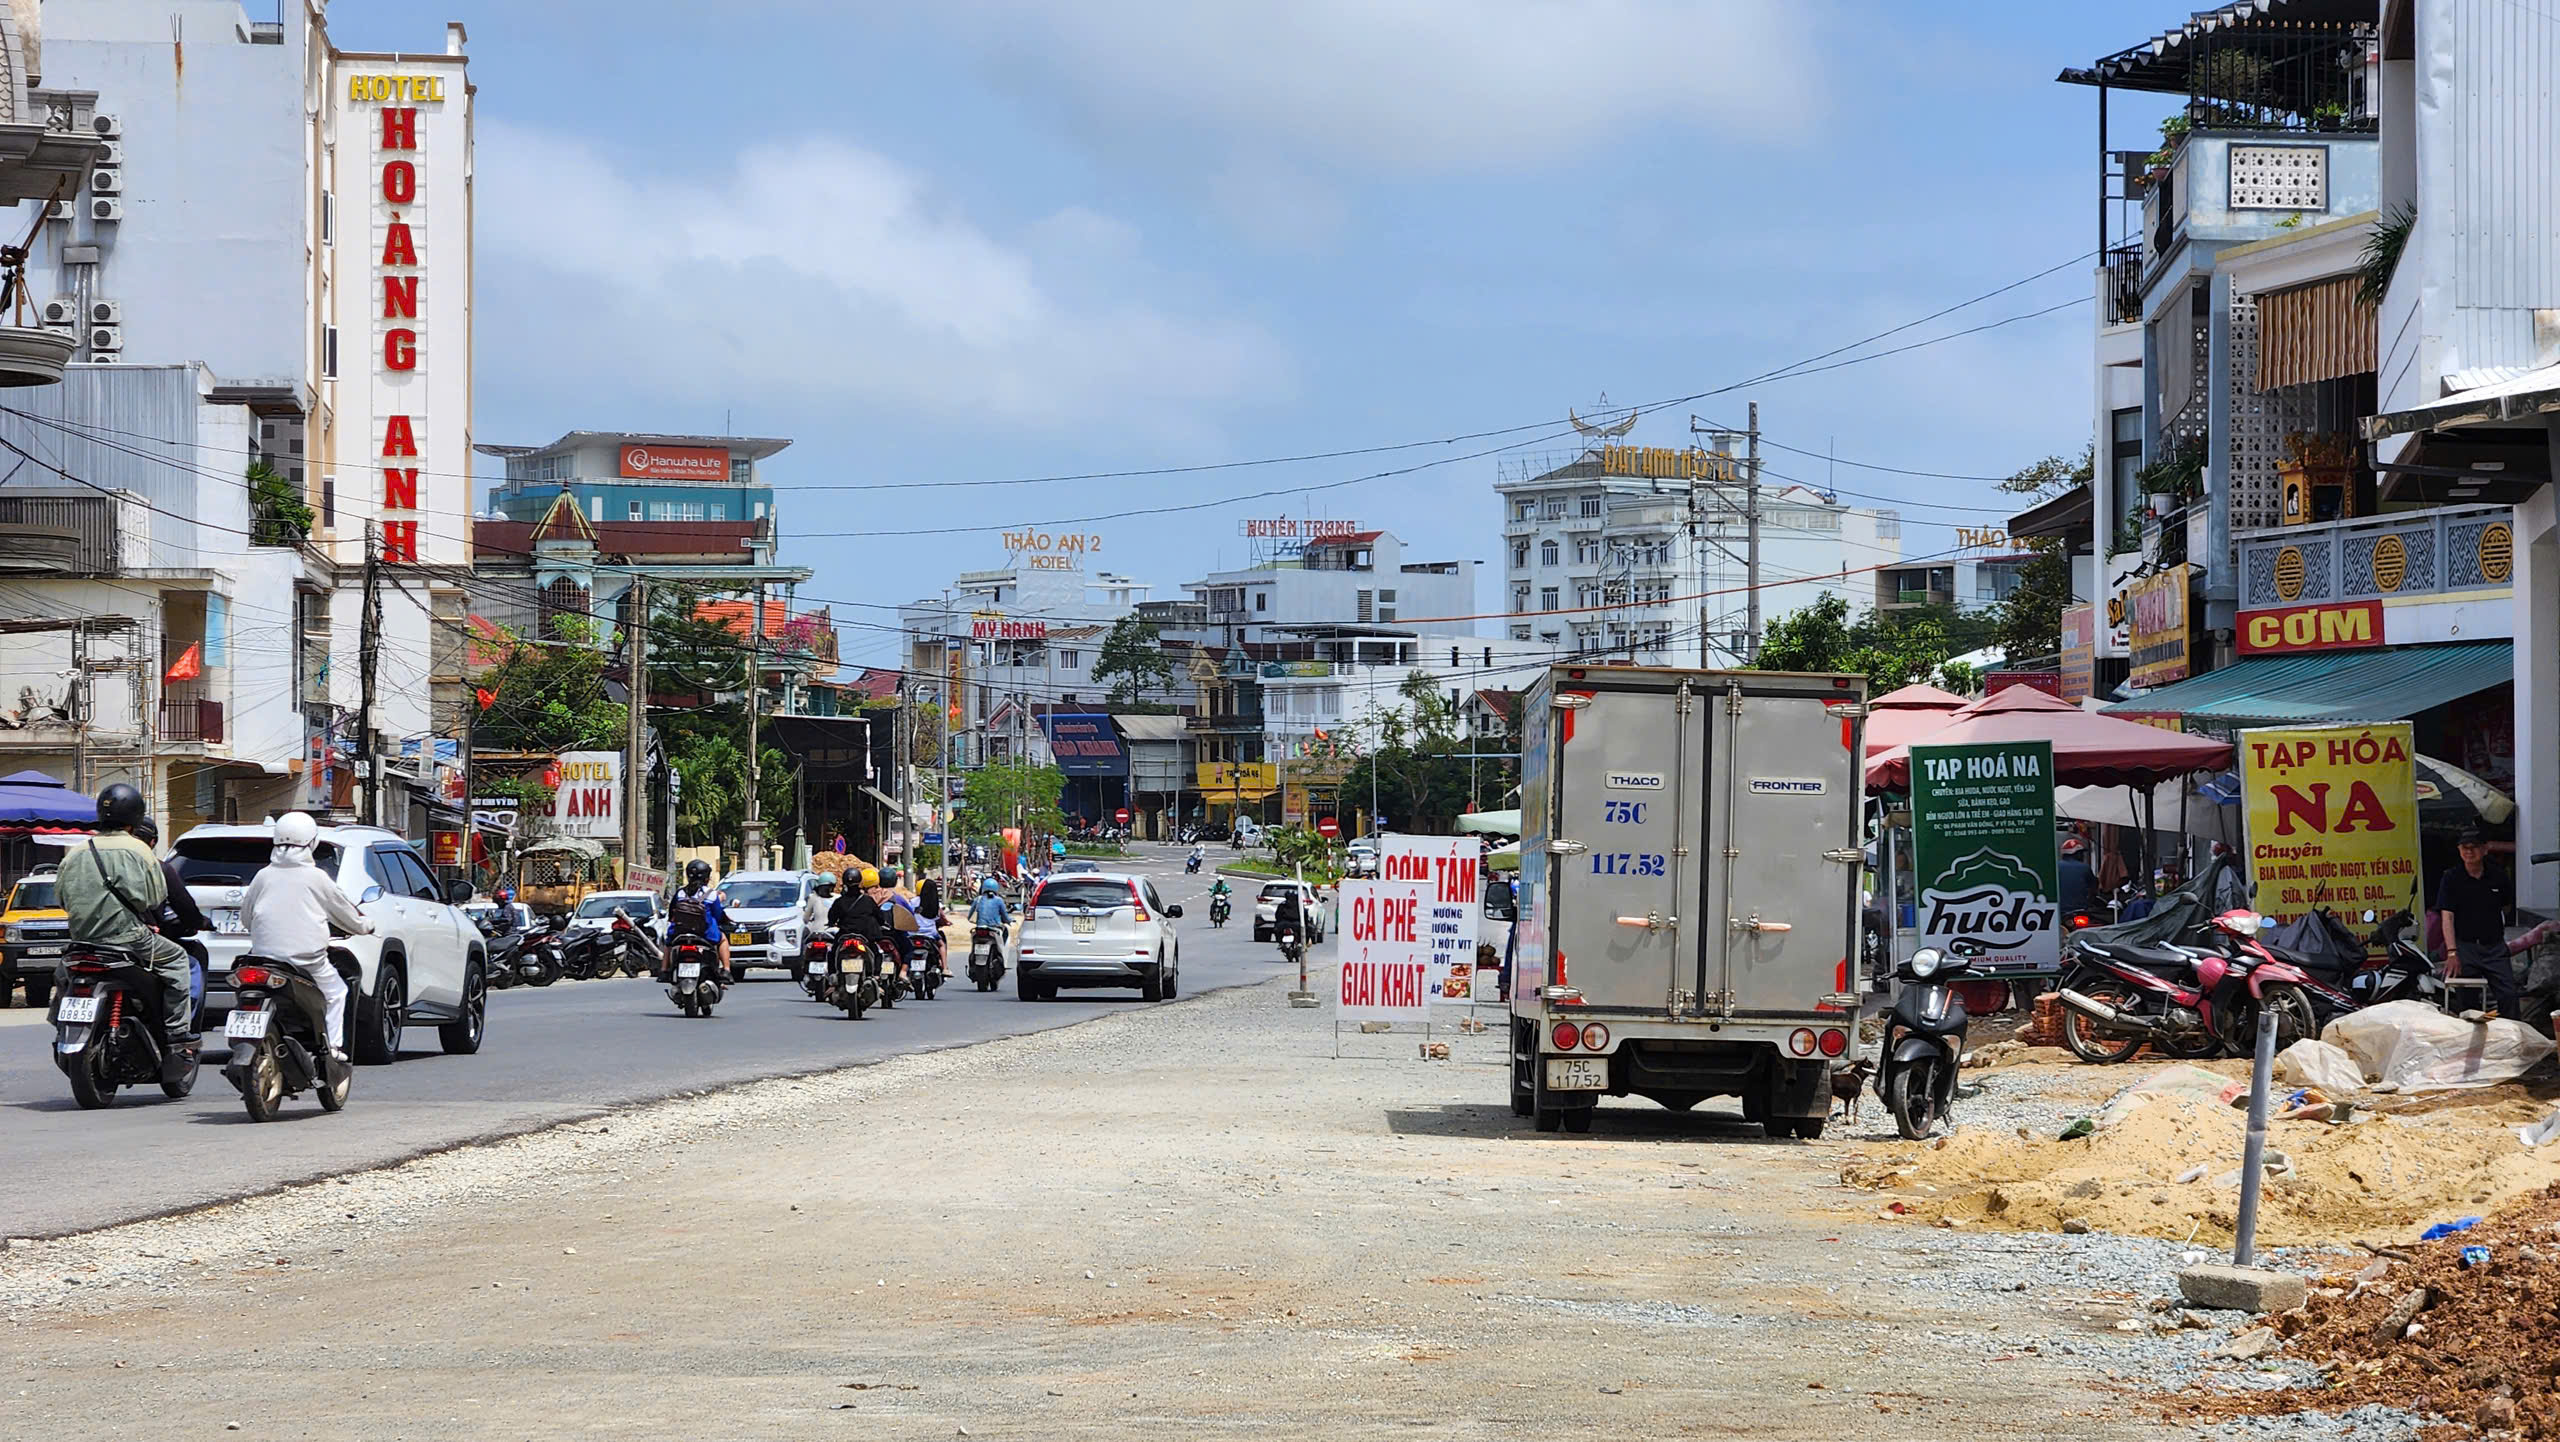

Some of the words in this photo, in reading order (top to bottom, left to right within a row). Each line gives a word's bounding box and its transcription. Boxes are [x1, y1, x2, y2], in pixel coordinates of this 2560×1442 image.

[351, 75, 444, 101] HOTEL
[382, 107, 418, 371] HOÀNG
[650, 456, 698, 467] Hanwha
[700, 458, 721, 467] Life
[382, 415, 418, 562] ANH
[1002, 527, 1051, 550] THẢO
[1058, 535, 1084, 551] AN
[1090, 536, 1101, 551] 2
[1304, 520, 1355, 537] TRANG
[1030, 556, 1072, 569] HOTEL
[972, 619, 996, 638] MỸ
[2249, 608, 2371, 648] CƠM
[2252, 742, 2316, 776] TẠP
[2328, 730, 2407, 766] HÓA
[560, 762, 613, 780] HOTEL
[1924, 759, 1962, 787] TẠP
[1967, 752, 2008, 779] HOÁ
[2013, 755, 2041, 778] NA
[1611, 776, 1660, 786] THACO
[1753, 780, 1822, 791] FRONTIER
[567, 788, 611, 817] ANH
[1605, 801, 1647, 824] 75C
[2270, 780, 2396, 836] NA
[2255, 842, 2323, 861] Chuyên
[1436, 842, 1476, 903] TẤM
[1591, 853, 1665, 876] 117.52
[2259, 866, 2276, 881] BIA
[2278, 864, 2308, 880] HUDA,
[2310, 860, 2337, 879] NƯỚC
[2340, 861, 2368, 880] NGỌT,
[2370, 856, 2389, 875] YẾN
[2392, 856, 2414, 875] SÀO,
[2336, 887, 2359, 905] KẸO,
[1353, 888, 1376, 941] CÀ
[1382, 889, 1418, 942] PHÊ
[2346, 908, 2358, 925] VÀ
[1434, 953, 1451, 966] BỘT
[1994, 954, 2028, 962] QUALITY
[1342, 947, 1376, 1006] GIẢI
[1381, 954, 1425, 1007] KHÁT
[60, 1009, 93, 1020] 088.59
[1564, 1060, 1590, 1073] 75C
[1556, 1074, 1601, 1088] 117.52
